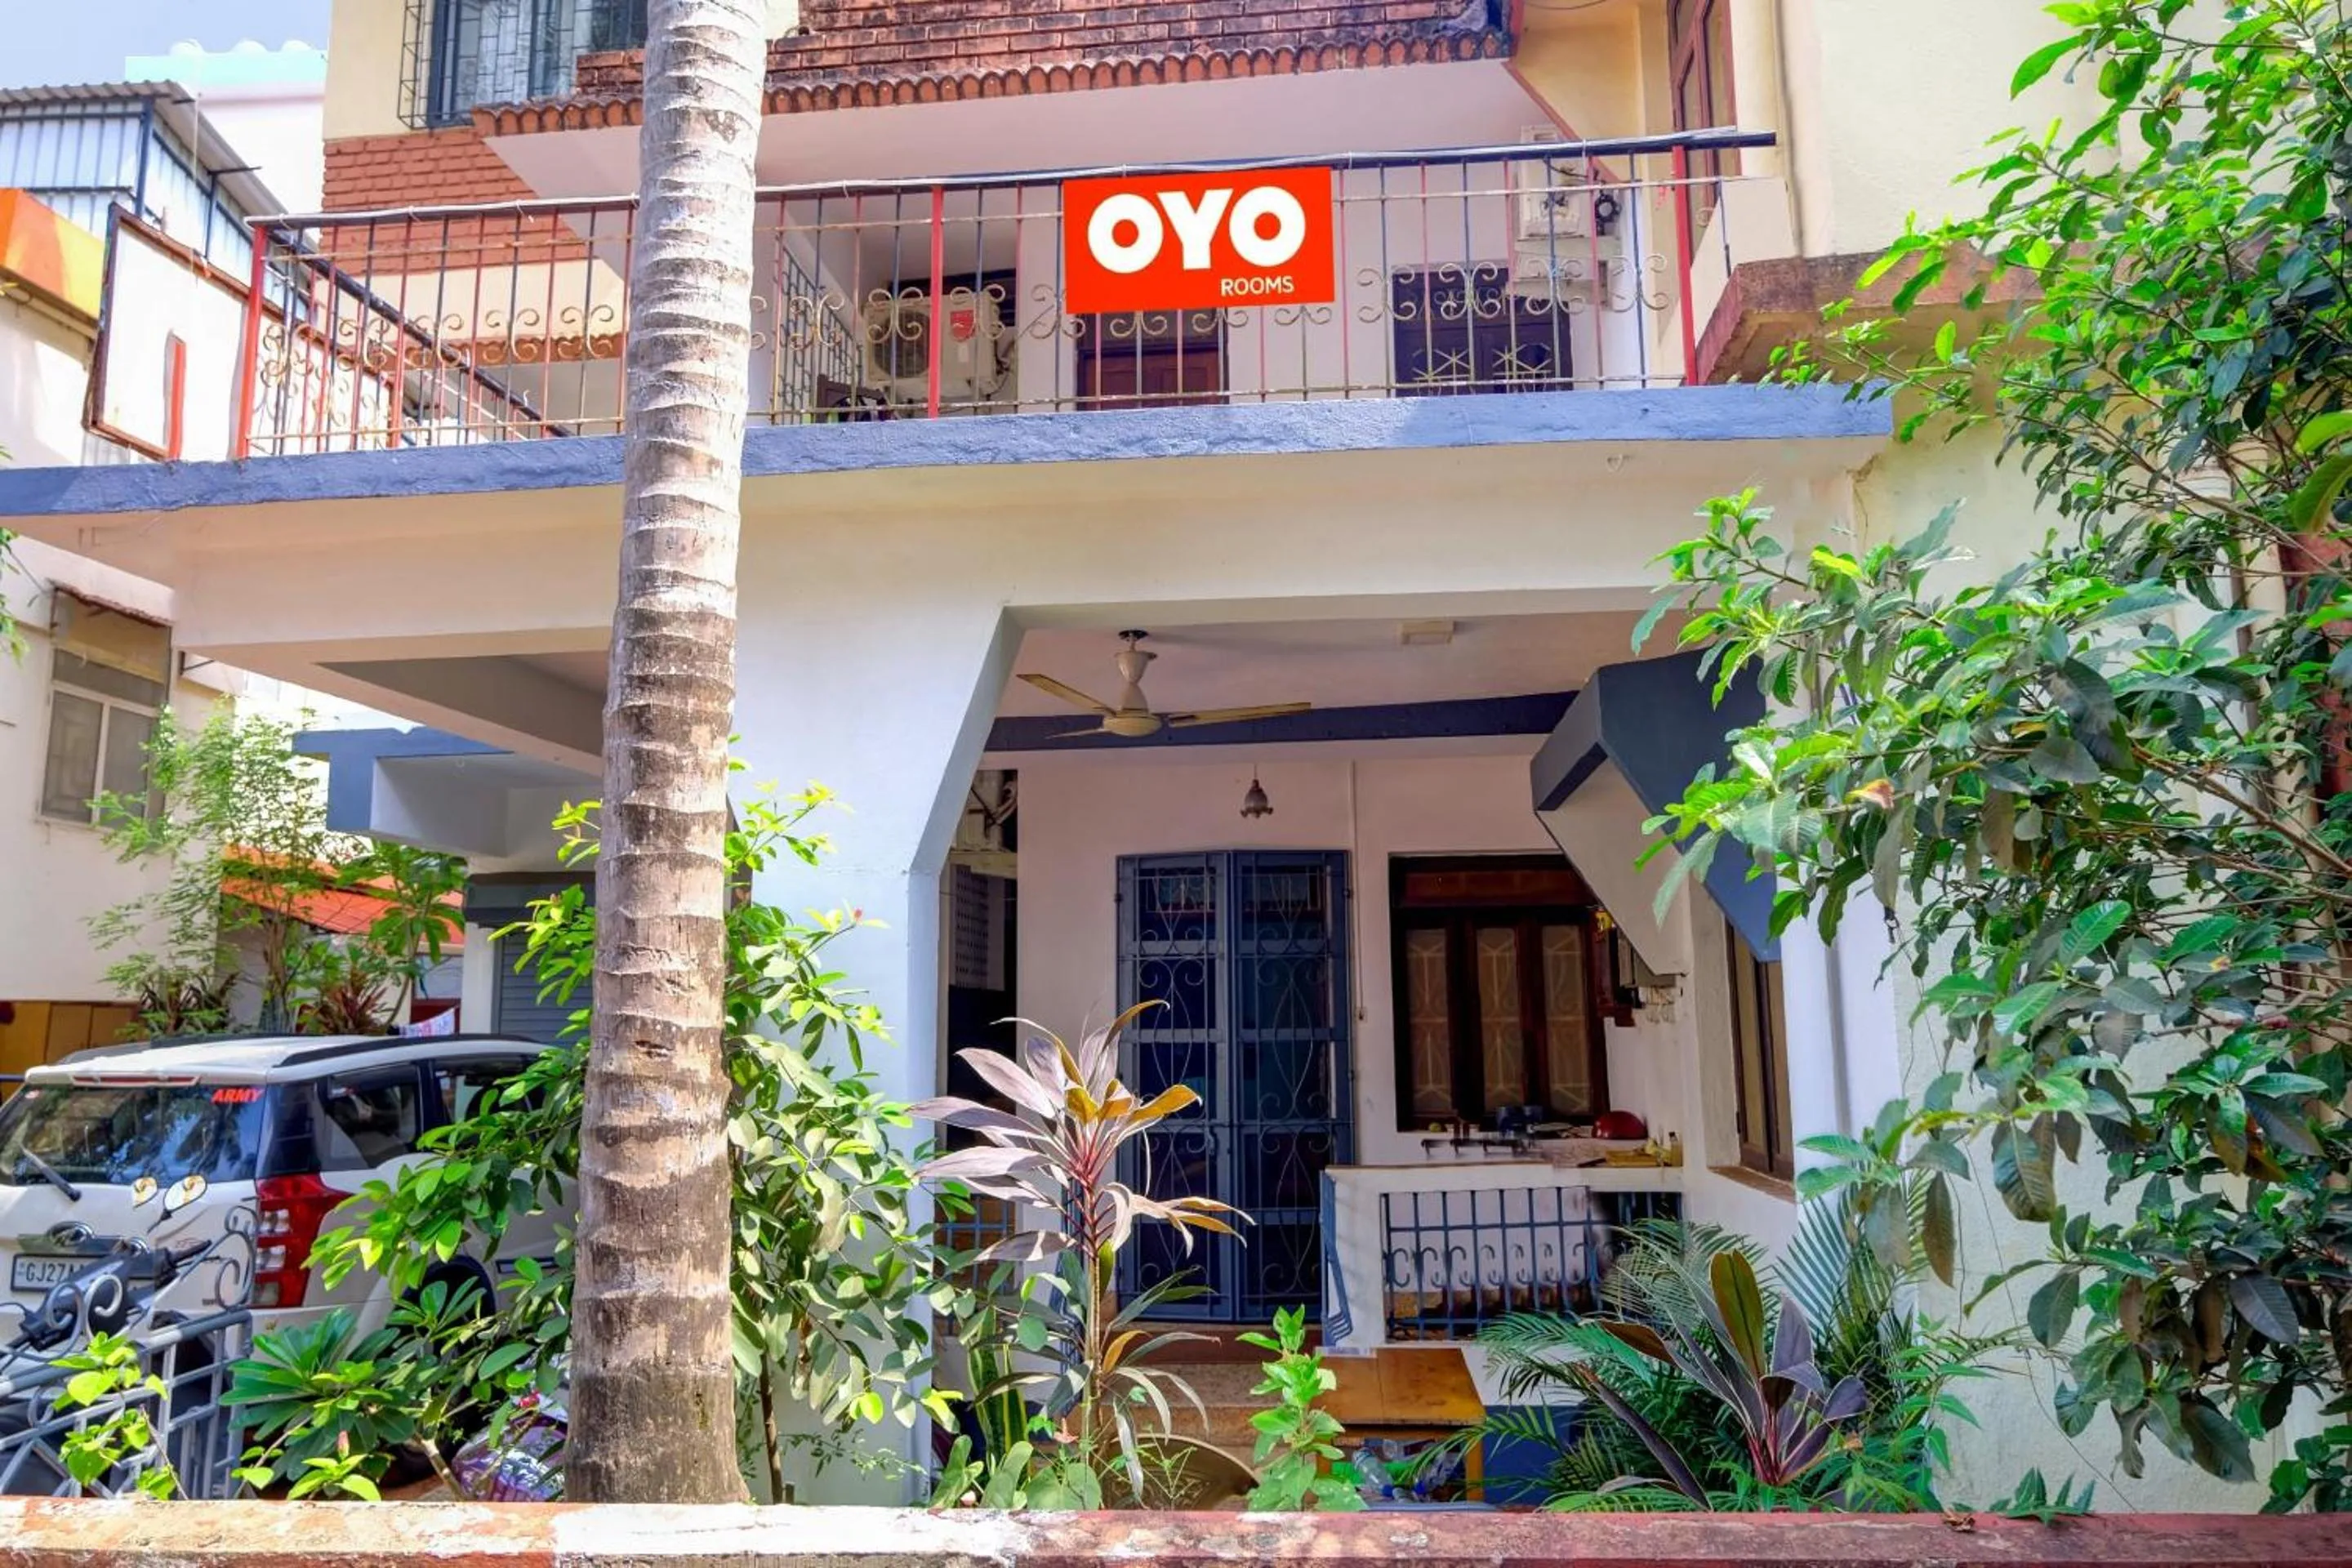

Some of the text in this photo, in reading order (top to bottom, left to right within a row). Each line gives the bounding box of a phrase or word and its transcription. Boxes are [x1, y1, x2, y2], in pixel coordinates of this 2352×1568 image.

[1088, 186, 1306, 274] OYO
[1220, 275, 1294, 296] ROOMS
[211, 1088, 264, 1103] ARMY
[25, 1262, 85, 1283] GJ27A
